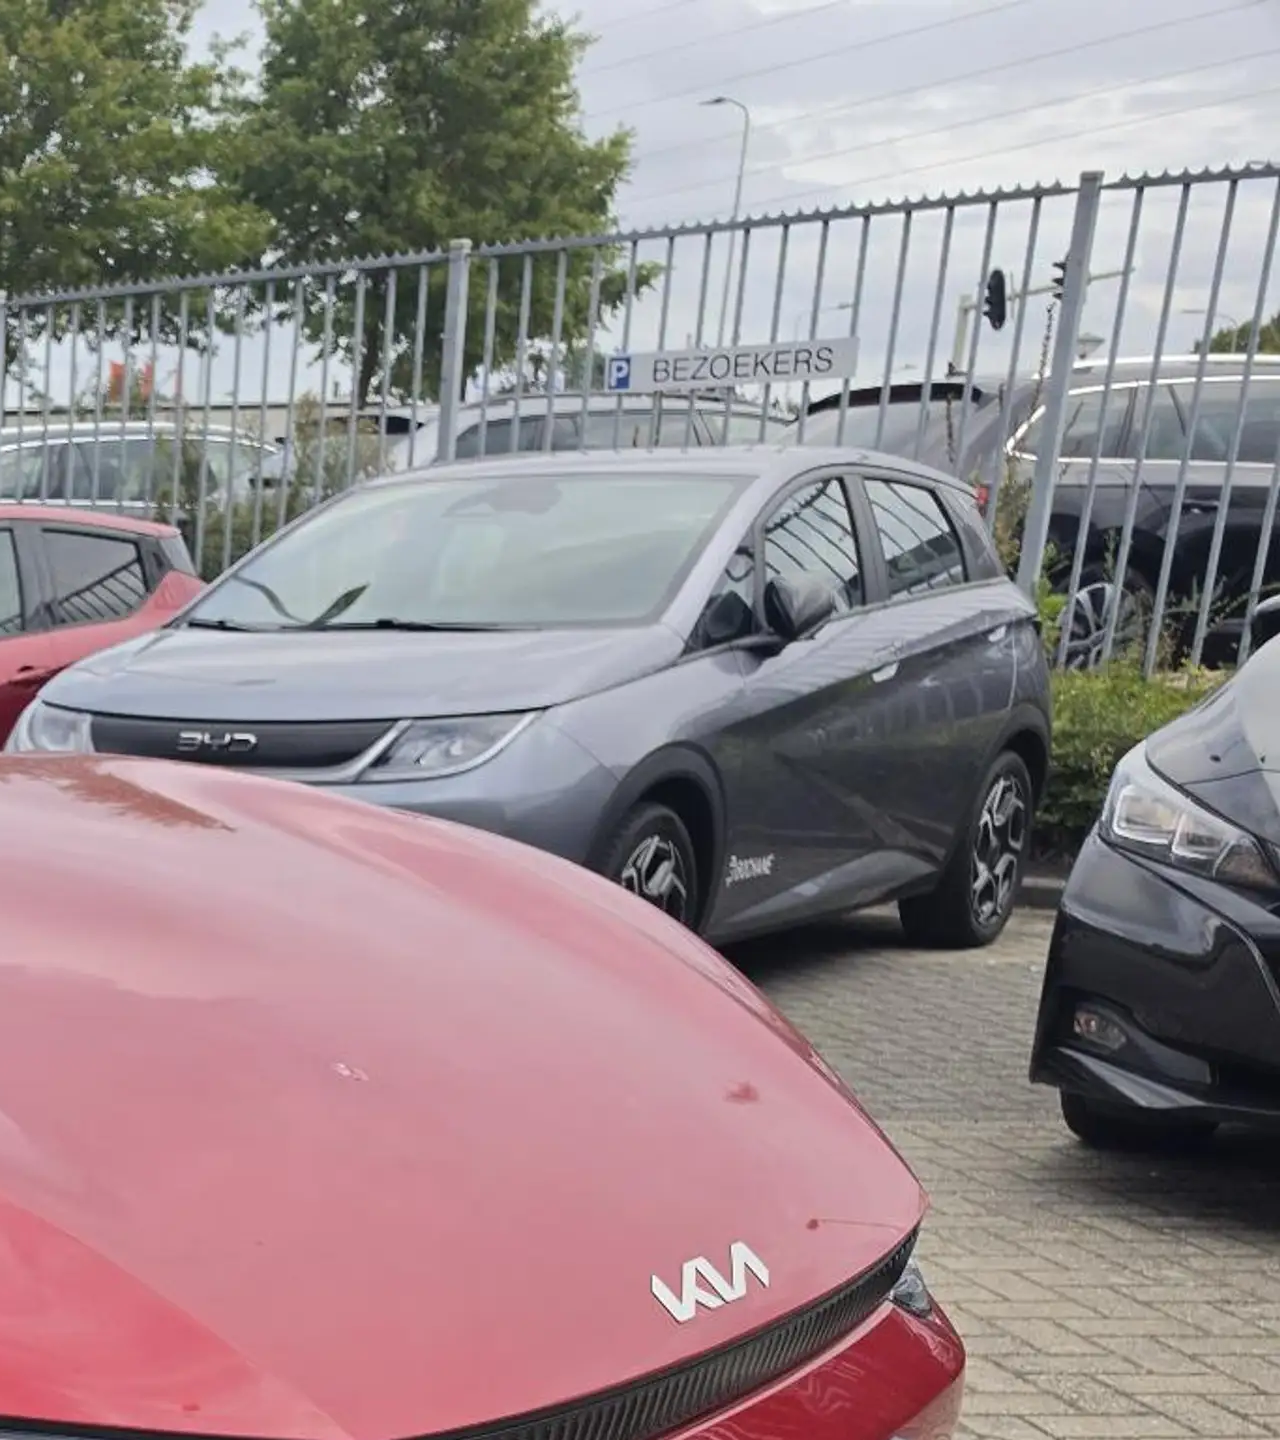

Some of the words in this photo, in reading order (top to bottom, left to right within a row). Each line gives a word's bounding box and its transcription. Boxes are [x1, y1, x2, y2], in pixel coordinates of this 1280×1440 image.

[652, 347, 834, 384] BEZOEKERS
[177, 731, 257, 752] BYD
[651, 1241, 770, 1324] KIA
